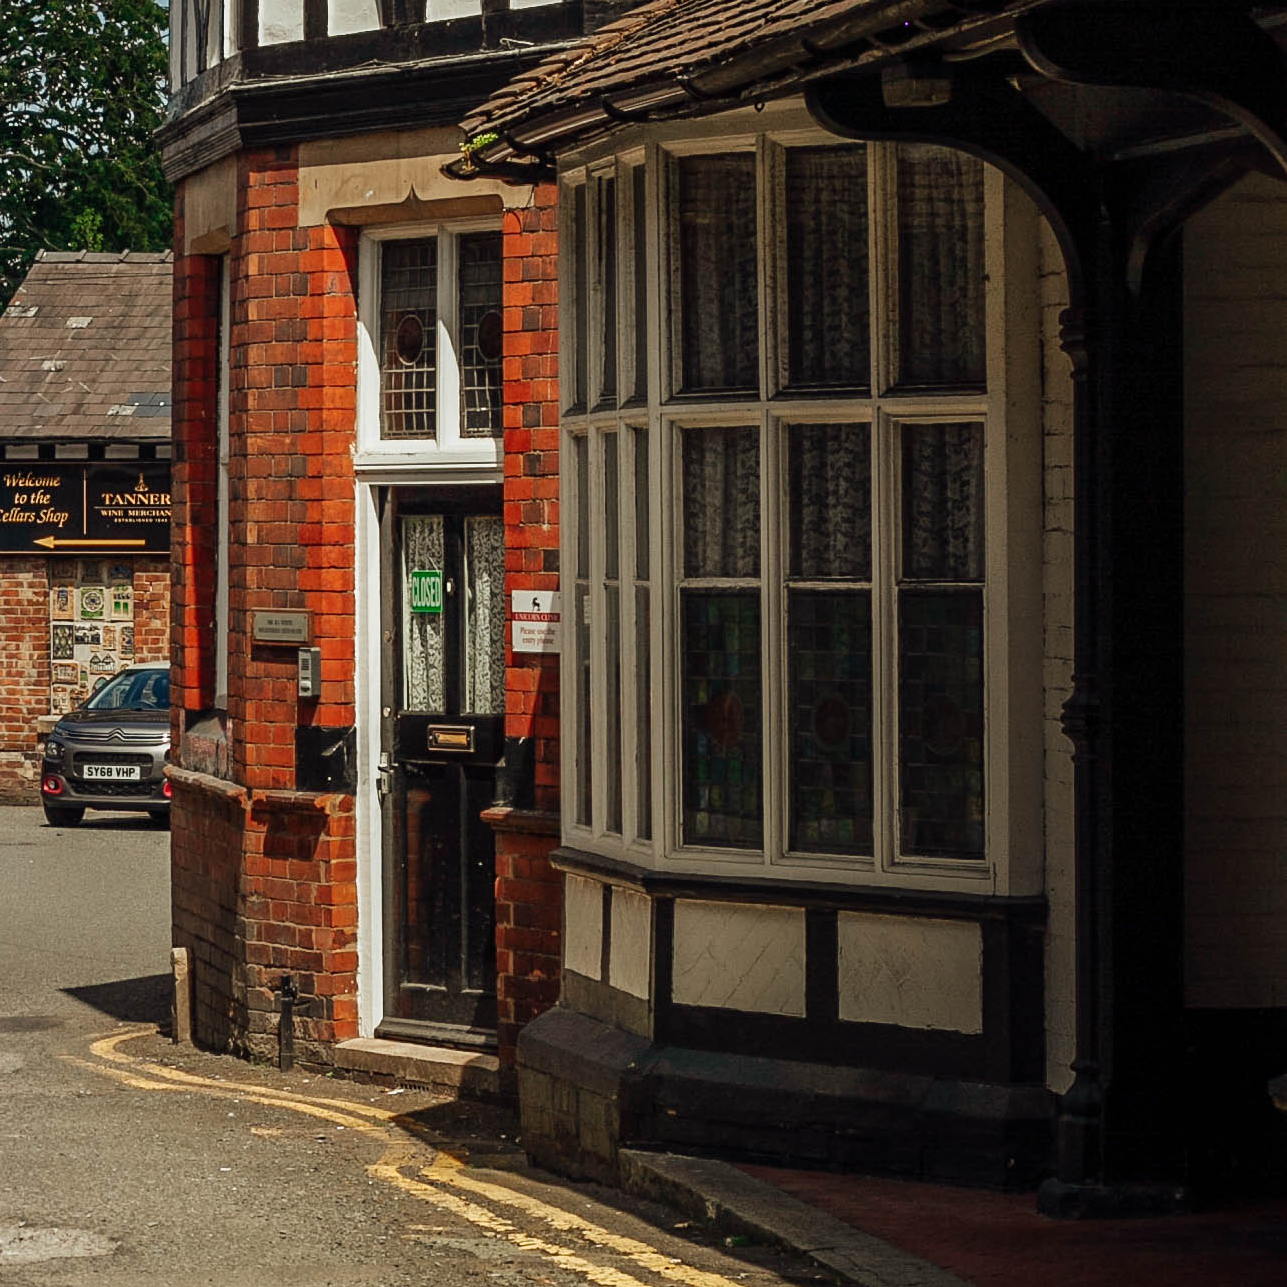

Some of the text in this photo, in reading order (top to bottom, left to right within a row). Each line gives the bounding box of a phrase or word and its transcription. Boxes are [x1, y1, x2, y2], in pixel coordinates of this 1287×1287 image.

[3, 472, 61, 487] Welcome
[14, 489, 51, 505] to the
[101, 493, 171, 505] TANNER
[36, 508, 69, 528] Shop
[100, 509, 171, 517] WINE MERCHAN
[412, 576, 441, 607] CLOSED
[87, 766, 135, 778] SY68 VHP
